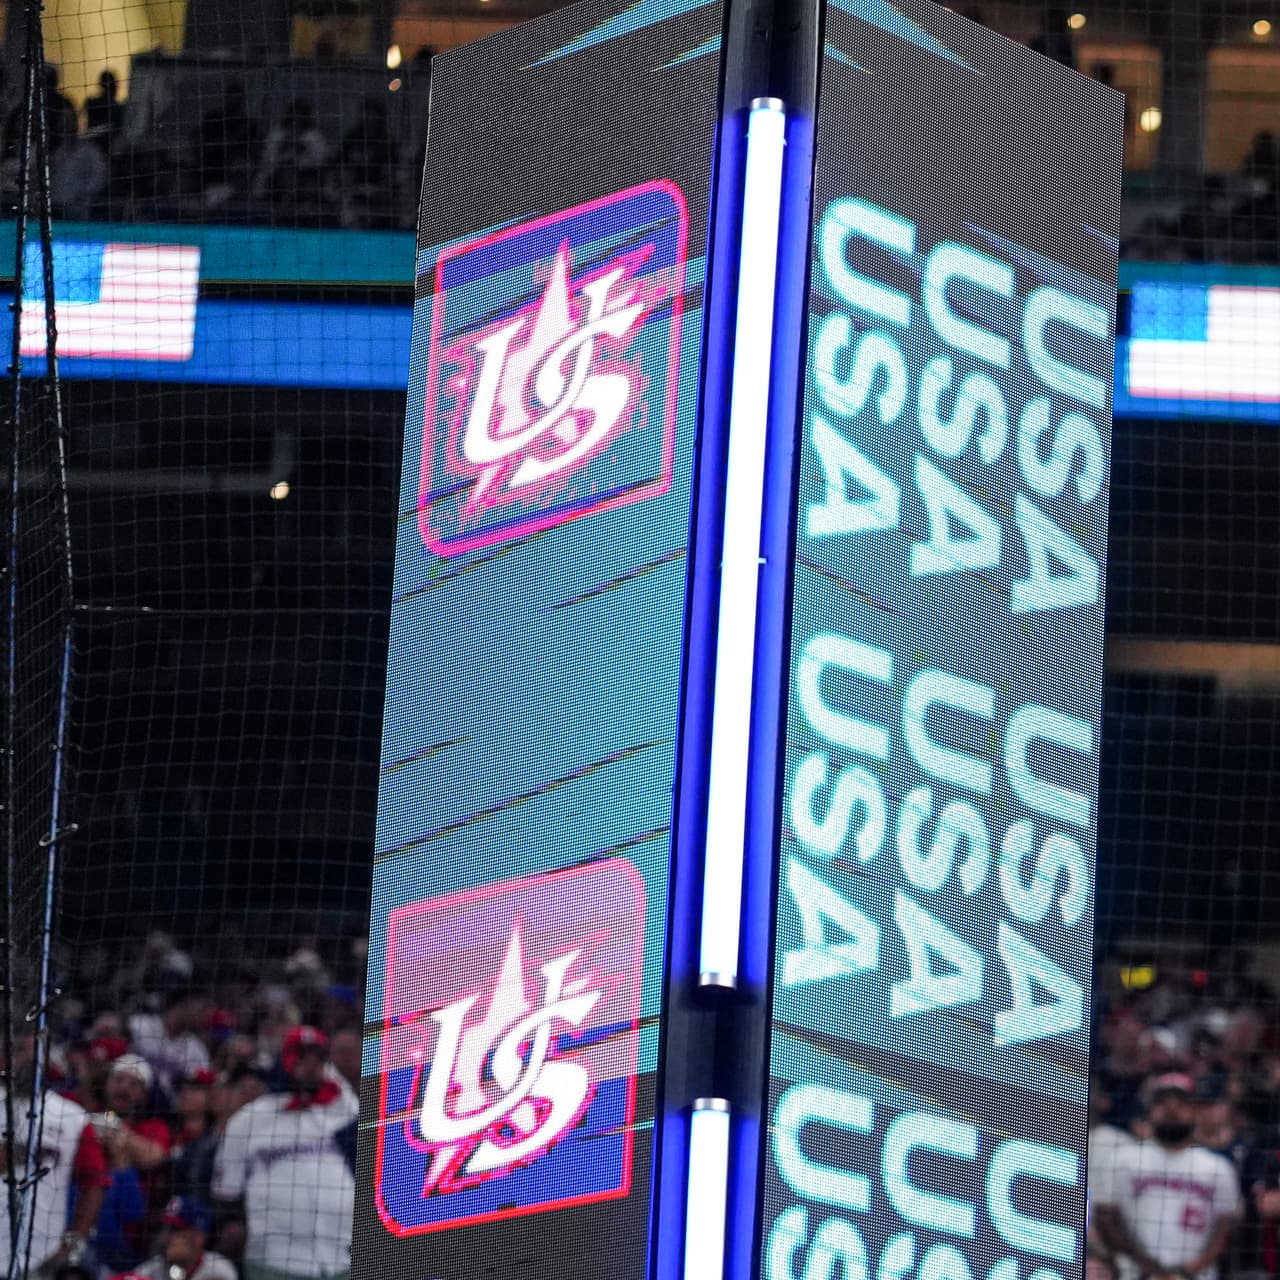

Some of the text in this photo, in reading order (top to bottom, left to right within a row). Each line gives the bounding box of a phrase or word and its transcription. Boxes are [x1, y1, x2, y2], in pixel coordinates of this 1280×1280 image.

[805, 198, 915, 540] USA
[909, 242, 1015, 578] USA
[1011, 286, 1108, 614] USA
[780, 630, 895, 990] USA
[887, 668, 997, 1020] USA
[992, 704, 1092, 1048] USA
